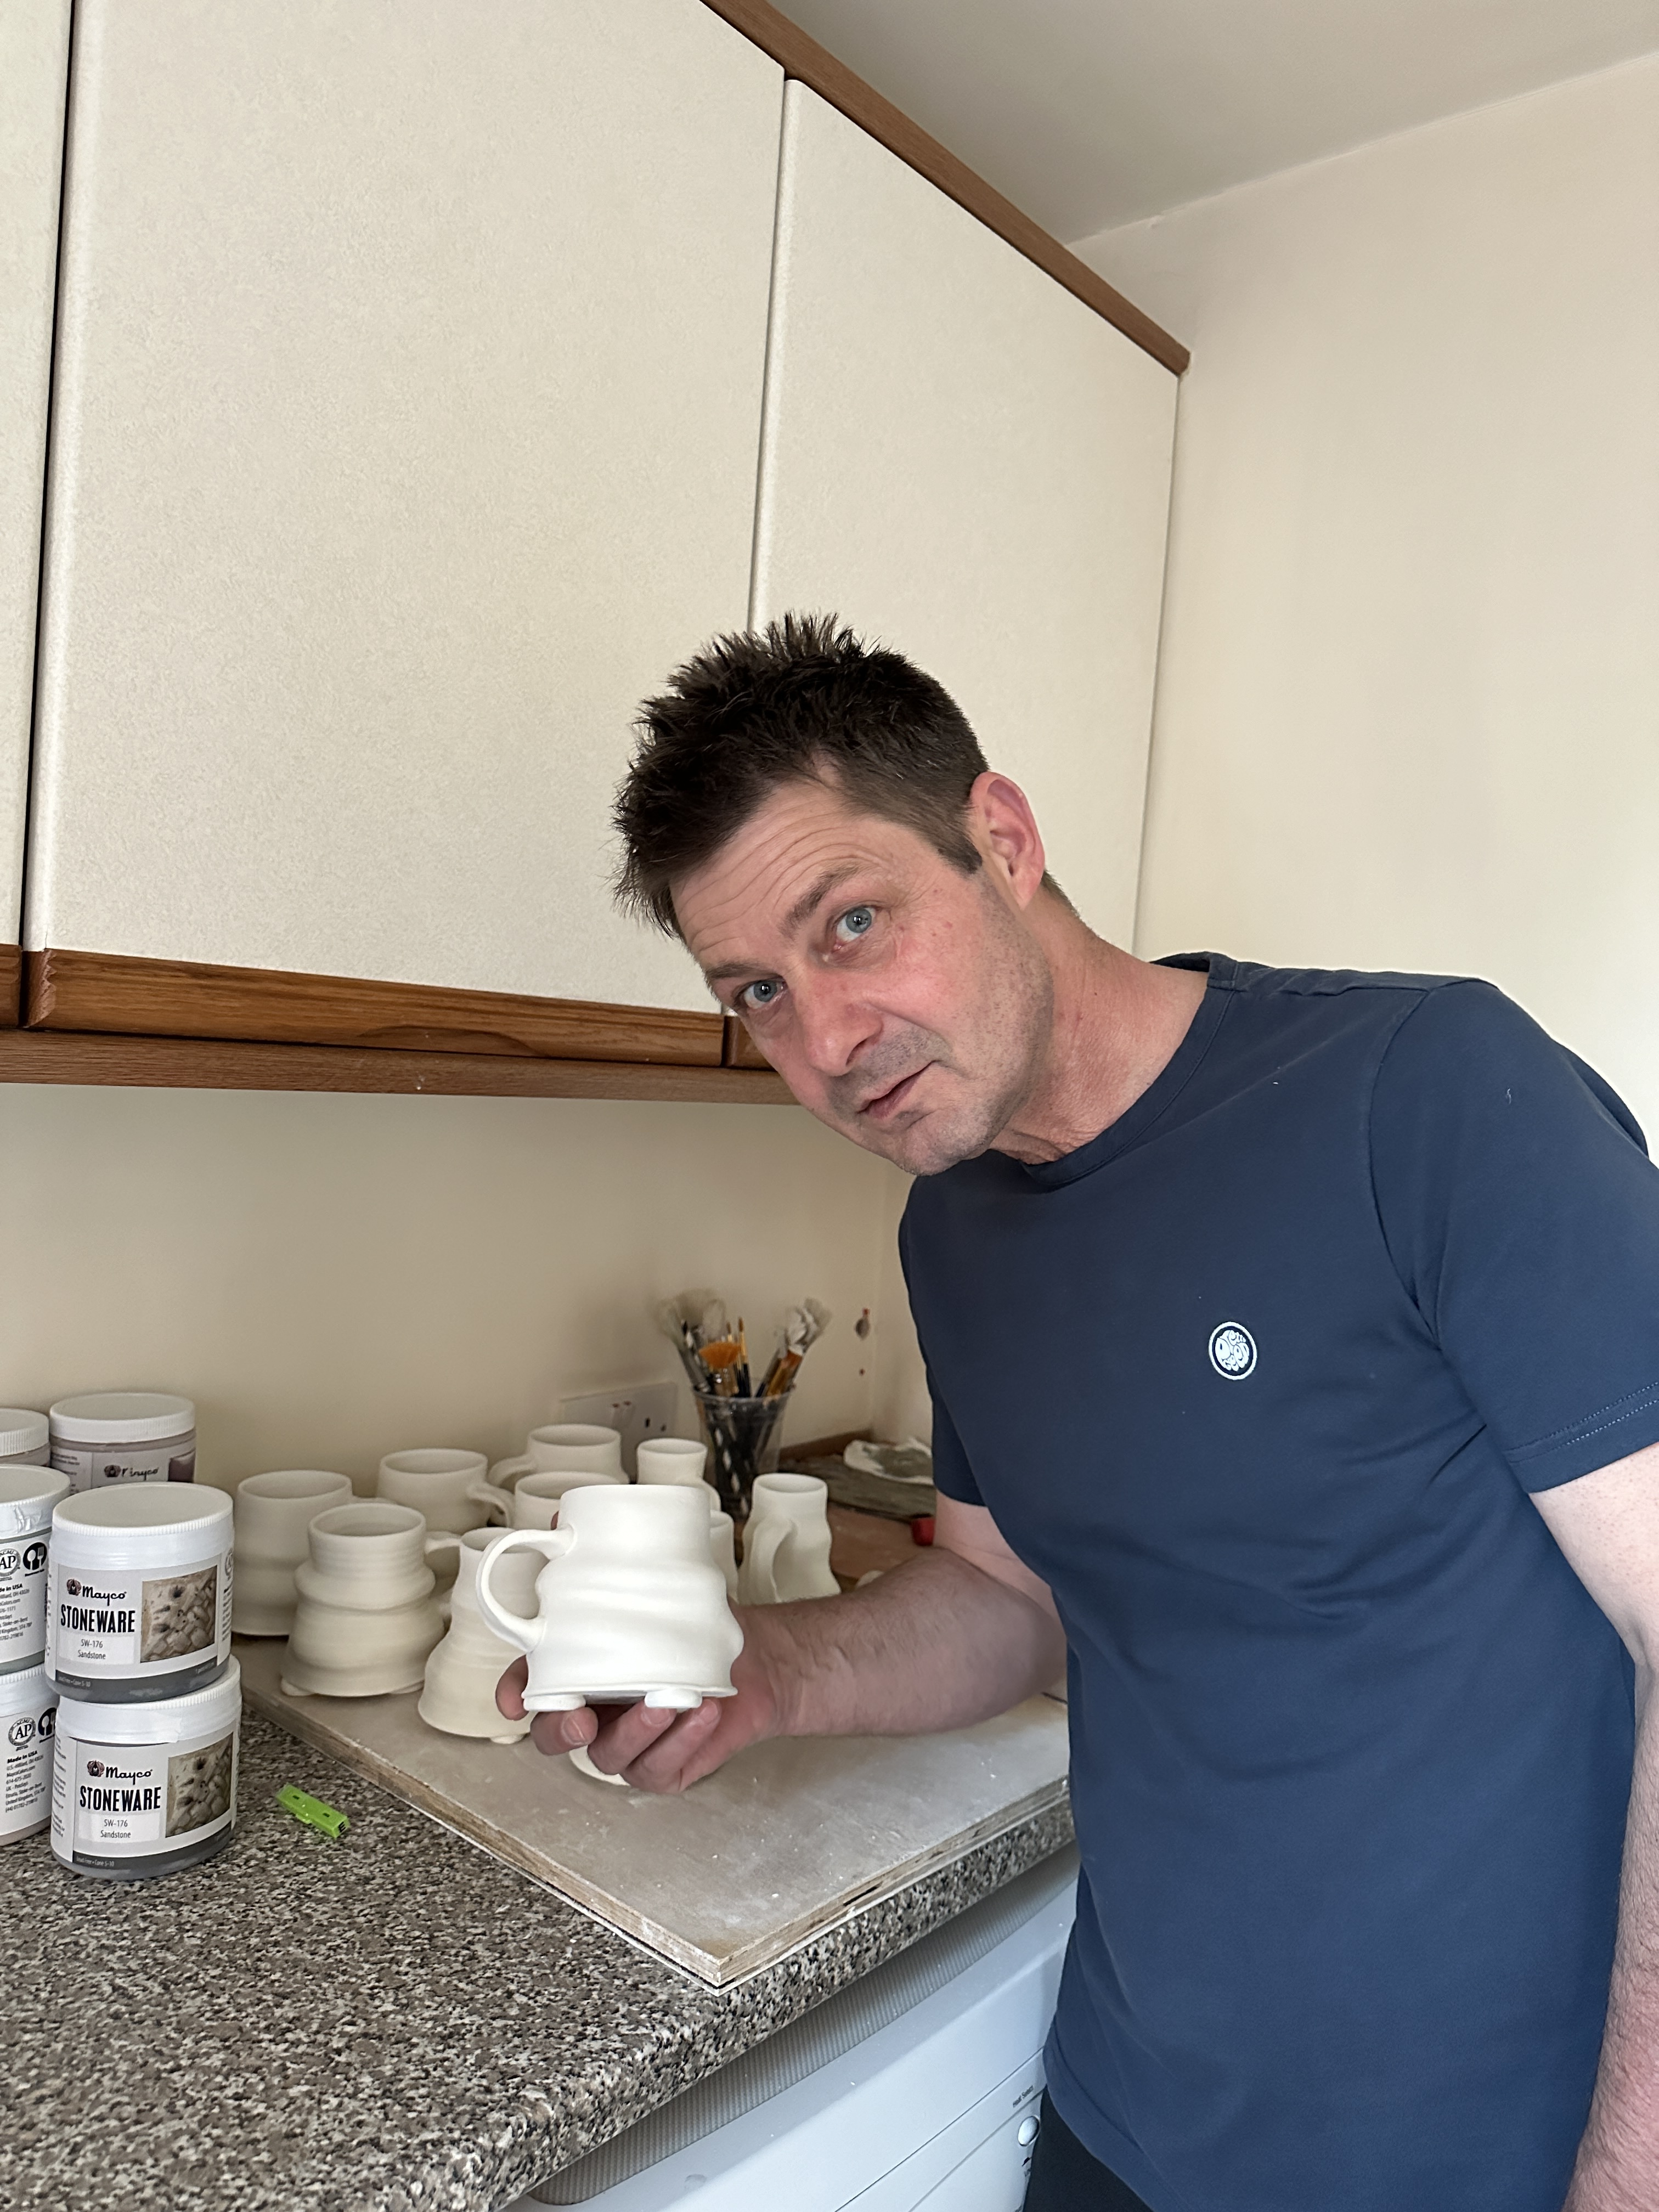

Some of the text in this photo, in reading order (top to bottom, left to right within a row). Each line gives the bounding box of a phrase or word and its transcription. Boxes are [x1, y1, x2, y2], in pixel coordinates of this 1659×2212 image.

[0, 1555, 16, 1569] AP
[82, 1585, 126, 1606] Mayco
[60, 1604, 136, 1633] STONEWARE
[81, 1639, 103, 1648] SW-176
[78, 1650, 106, 1660] Sandstone
[14, 1724, 32, 1740] AP
[106, 1767, 152, 1785] Mayco
[80, 1785, 161, 1812] STONEWARE
